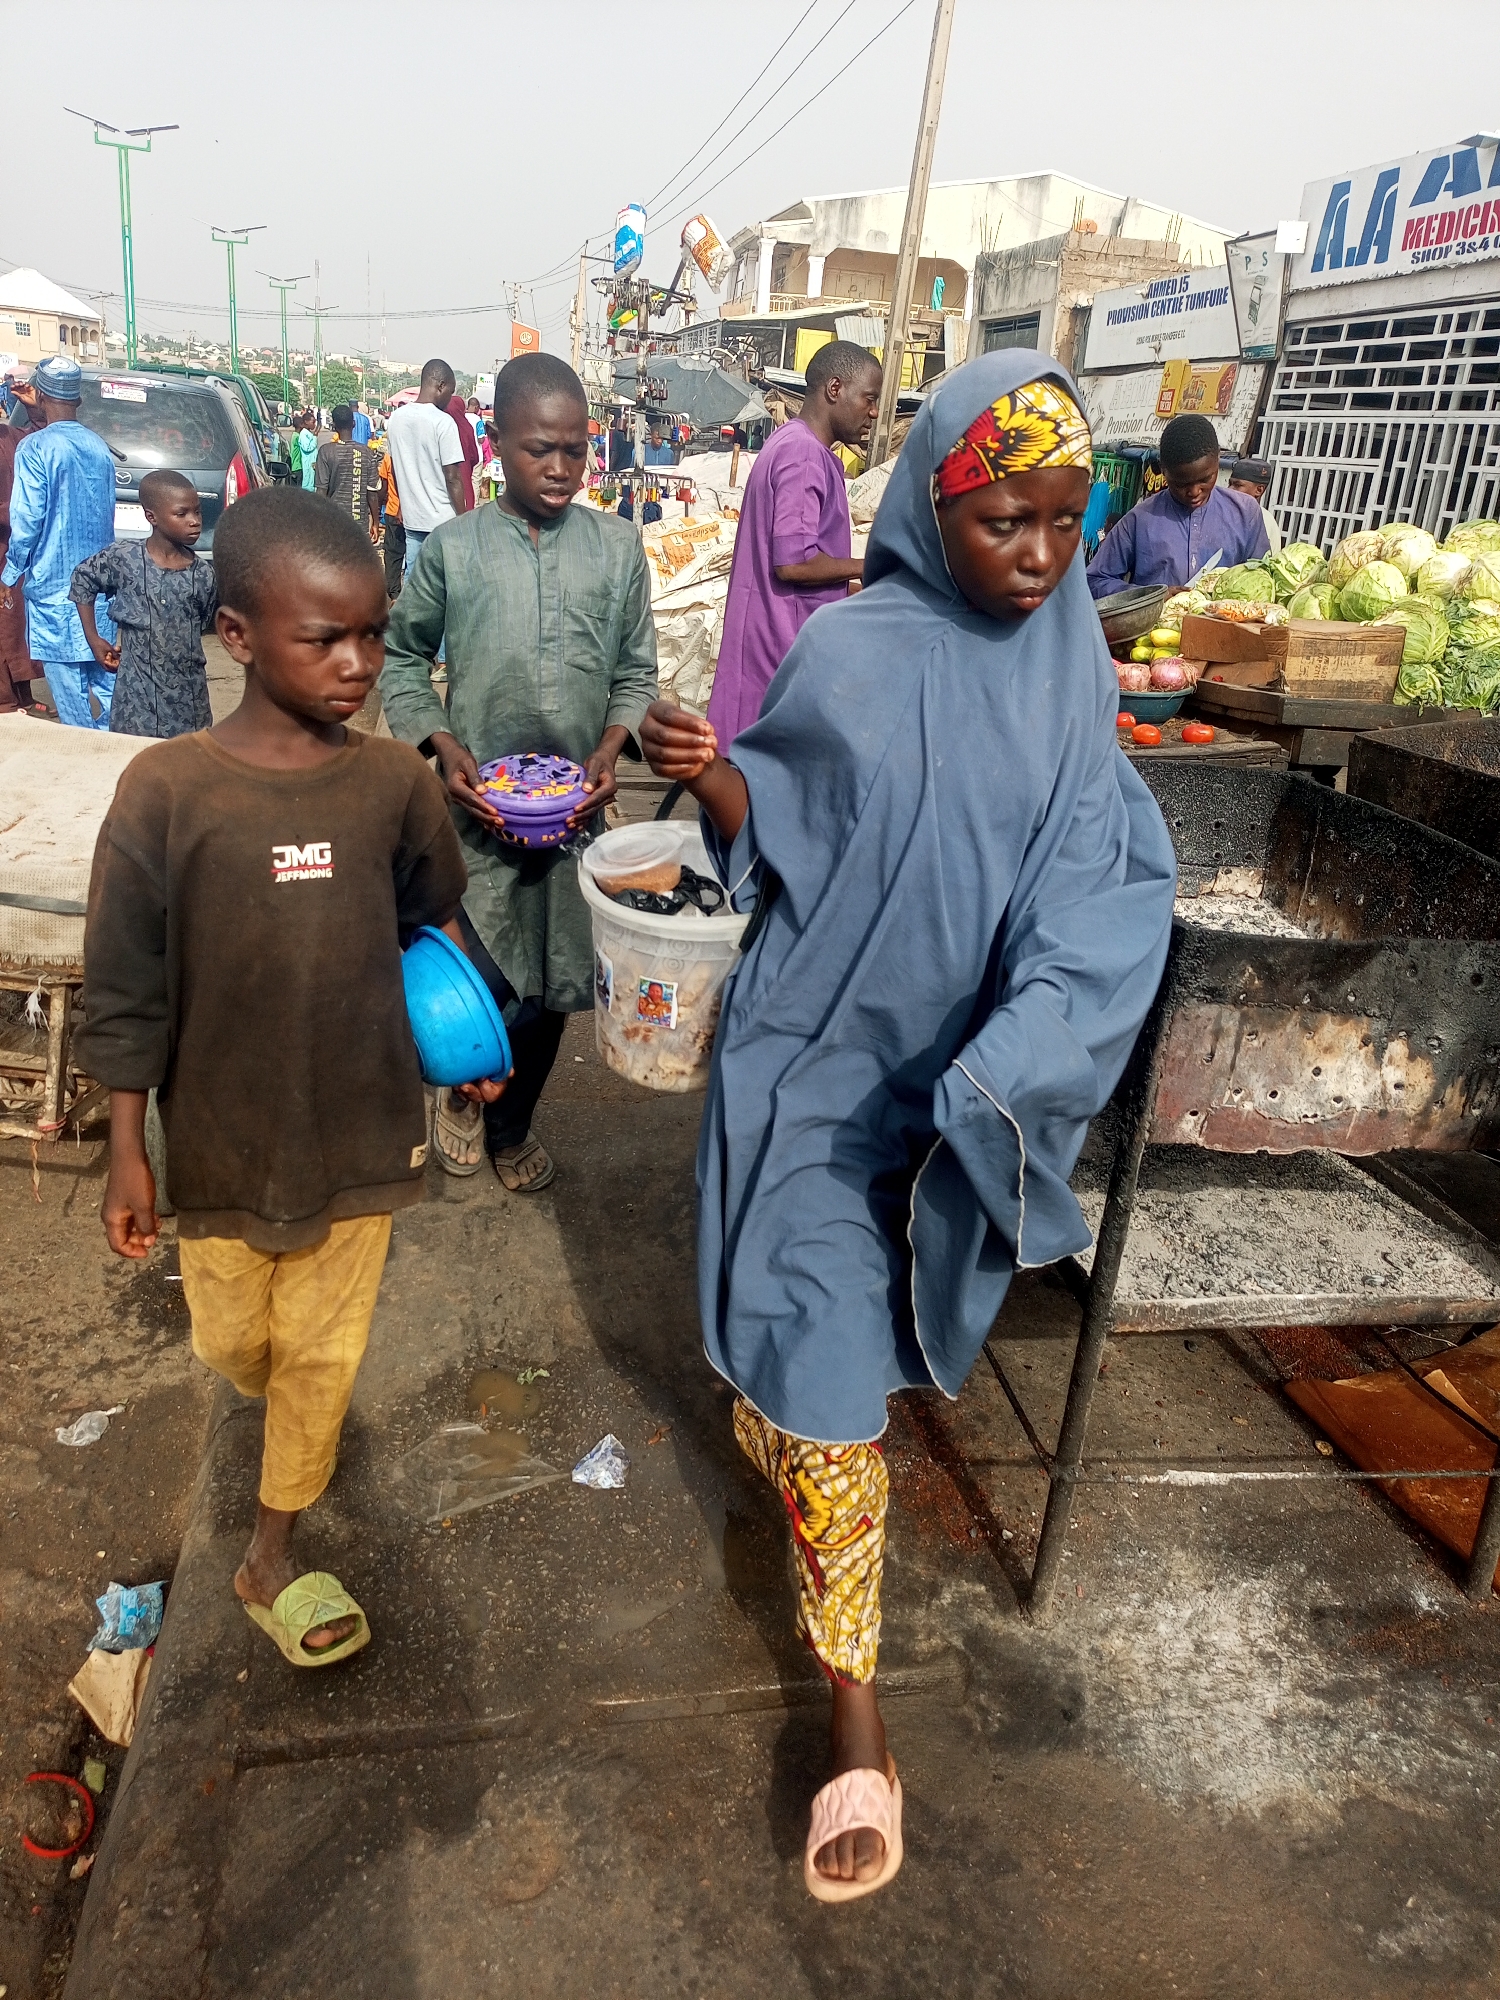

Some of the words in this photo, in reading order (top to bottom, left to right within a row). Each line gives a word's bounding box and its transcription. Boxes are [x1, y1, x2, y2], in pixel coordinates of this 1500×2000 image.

[1411, 244, 1453, 265] SHOP
[1455, 236, 1490, 256] 3&4
[1147, 278, 1178, 299] AHMED
[1106, 302, 1150, 326] PROVISION
[1150, 295, 1184, 318] CENTRE
[1184, 286, 1229, 311] TUMFURE
[1109, 373, 1162, 410] AHME
[1105, 413, 1143, 435] Provision
[352, 448, 361, 520] AUSTRALIA
[272, 842, 332, 869] JMG
[275, 867, 333, 883] JEFFMONG
